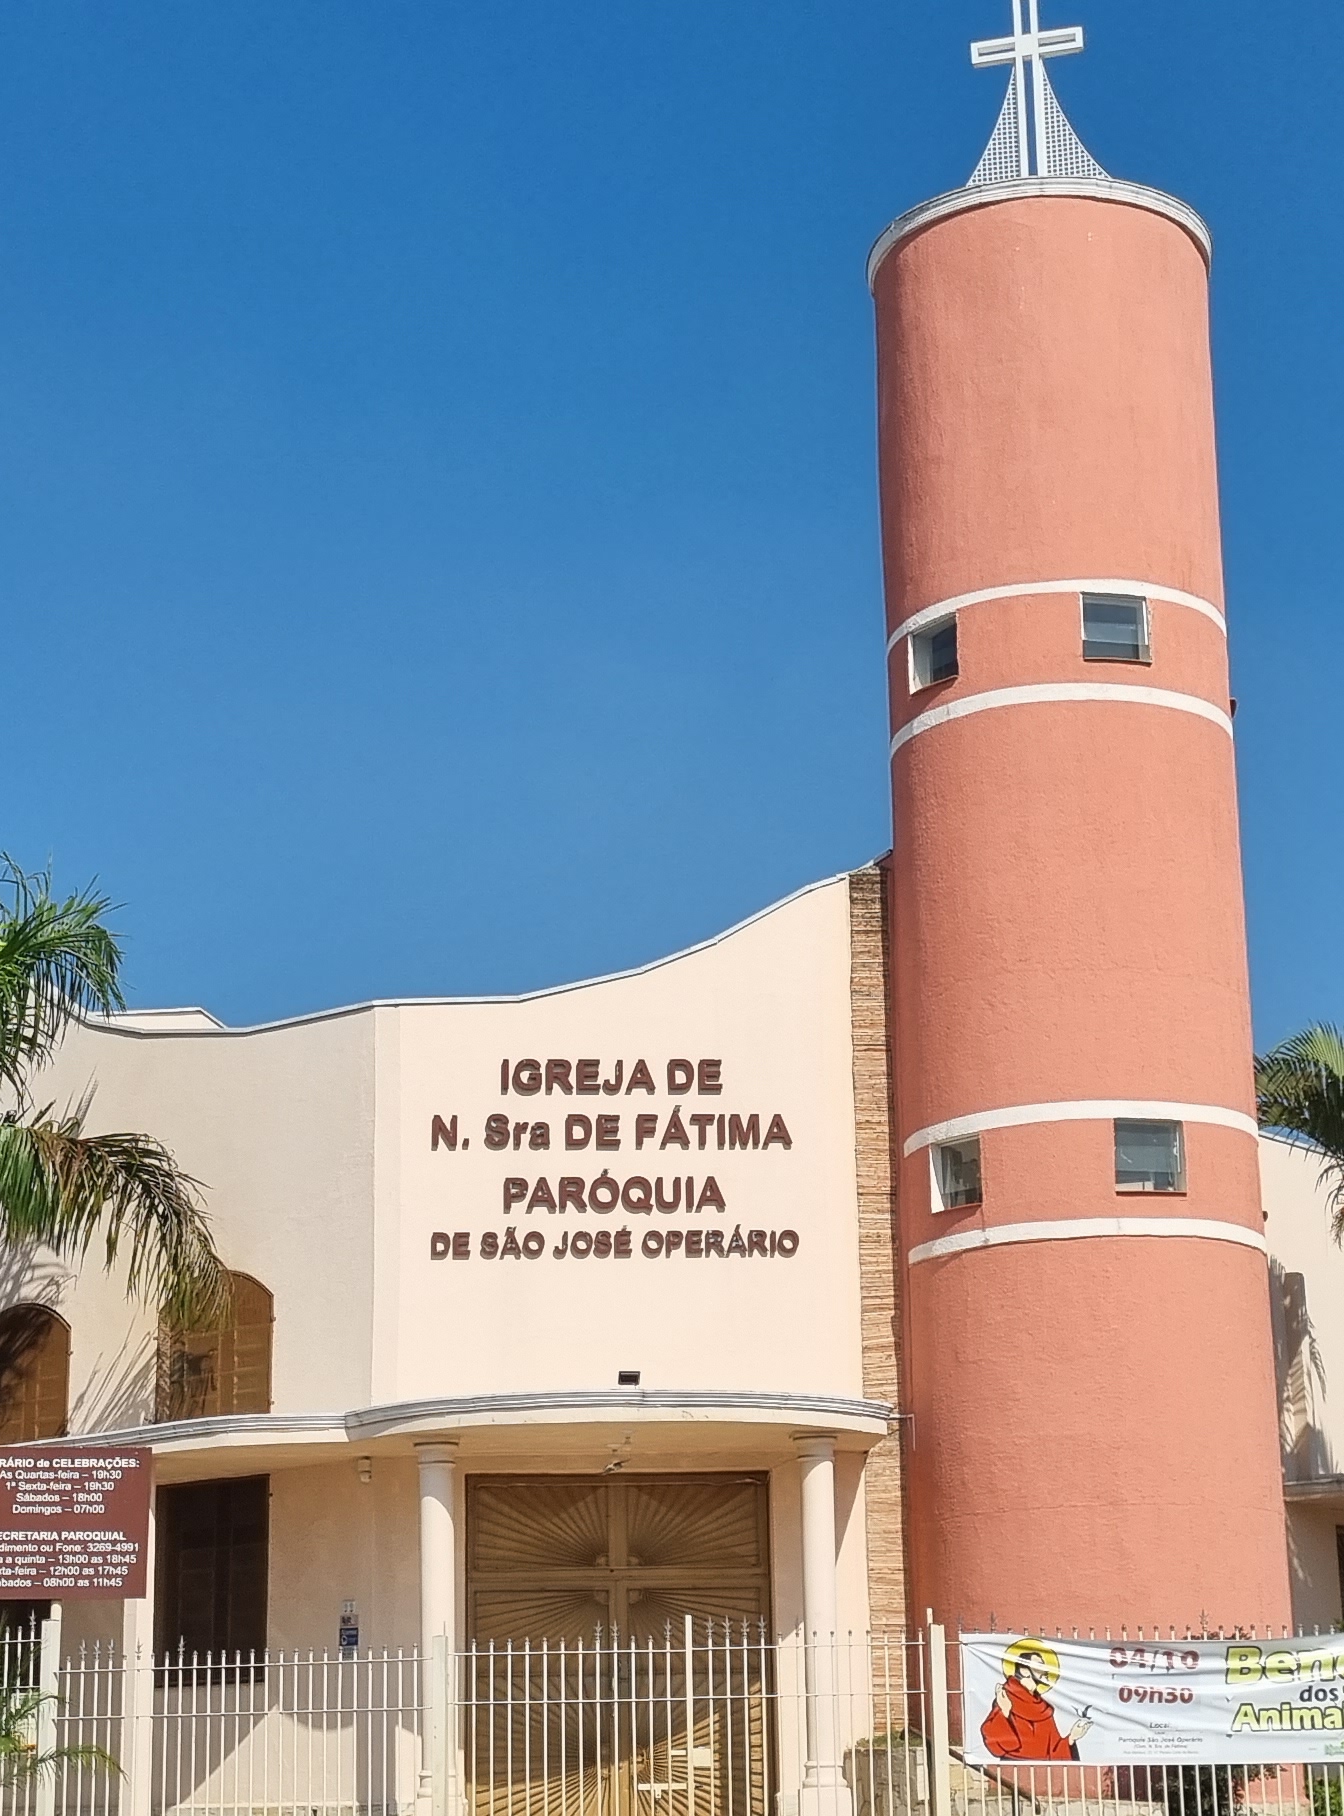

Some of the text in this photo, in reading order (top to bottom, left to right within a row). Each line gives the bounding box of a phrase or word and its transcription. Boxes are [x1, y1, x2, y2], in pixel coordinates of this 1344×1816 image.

[500, 1058, 723, 1096] IGREJA DE
[431, 1105, 792, 1150] N. Sra DE FÁTIMA
[503, 1168, 726, 1216] PARÓQUIA
[431, 1224, 799, 1260] DE SÃO JOSÉ OPERÁRIO
[37, 1459, 50, 1467] de
[53, 1457, 140, 1469] CELEBRAÇÕES:
[15, 1470, 79, 1479] Quartas-feira
[92, 1470, 121, 1478] 19h30
[18, 1482, 71, 1490] Sexta-feira
[84, 1482, 114, 1490] 19h30
[16, 1493, 60, 1502] Sábados
[72, 1493, 102, 1502] 18h00
[13, 1505, 62, 1515] Domingos
[74, 1505, 104, 1514] 07h00
[62, 1531, 126, 1541] PAROQUIAL
[56, 1543, 84, 1552] Fone:
[87, 1543, 138, 1552] 3269-4991
[15, 1555, 45, 1565] quinta
[58, 1555, 88, 1563] 13h00
[106, 1555, 136, 1563] 18h45
[50, 1567, 79, 1575] 12h00
[98, 1567, 128, 1575] 17h45
[43, 1578, 74, 1587] 08h00
[93, 1578, 122, 1587] 11h45
[1299, 1684, 1339, 1703] dos
